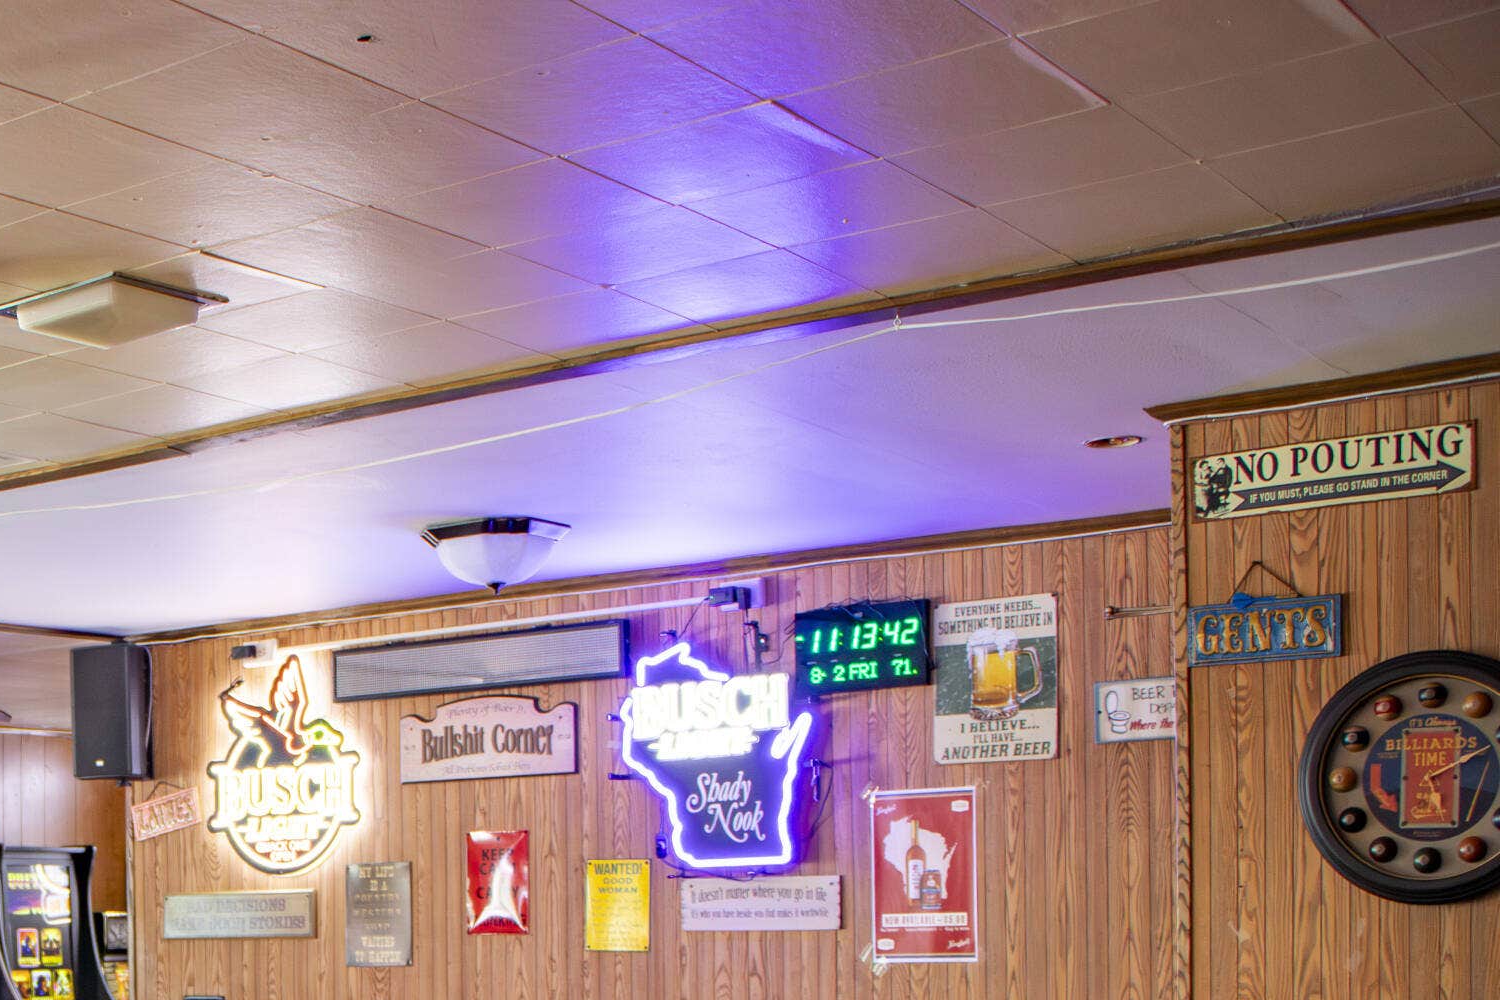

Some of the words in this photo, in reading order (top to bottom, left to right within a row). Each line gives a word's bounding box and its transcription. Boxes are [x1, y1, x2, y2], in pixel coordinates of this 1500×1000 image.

[1233, 451, 1279, 485] NO
[1290, 425, 1464, 477] POUTING
[1249, 494, 1258, 503] IF
[1259, 490, 1276, 502] YOU
[1303, 482, 1335, 498] PLEASE
[1336, 480, 1349, 493] GO
[1350, 477, 1379, 491] STAND
[1380, 476, 1390, 487] IN
[1390, 473, 1410, 487] THE
[1411, 468, 1449, 484] CORNER
[954, 605, 1001, 618] EVERYONE
[991, 616, 1003, 630] TO
[1004, 612, 1041, 629] BELIEVE
[1043, 611, 1053, 625] IN
[811, 615, 921, 654] 11:13:42
[1196, 604, 1327, 656] GENTS
[848, 660, 879, 681] FRI
[1131, 685, 1165, 700] BEER
[631, 672, 790, 740] BUSCH
[960, 723, 965, 734] I
[1130, 718, 1157, 731] Where
[1160, 717, 1175, 728] the
[420, 723, 485, 765] Bullshit
[491, 723, 554, 756] Corner
[941, 744, 1010, 760] ANOTHER
[1013, 741, 1052, 756] BEER
[1385, 736, 1478, 751] BILLIARDS
[1414, 751, 1448, 767] TIME
[217, 763, 355, 825] BUSCH
[685, 770, 752, 813] Shady
[704, 801, 767, 844] Nook
[482, 848, 515, 861] KEEP
[594, 863, 643, 875] WANTED!
[698, 886, 724, 903] doesn't
[725, 887, 750, 900] matter
[751, 883, 776, 899] where
[777, 887, 792, 902] you
[794, 888, 804, 902] go
[248, 914, 307, 929] STORIES
